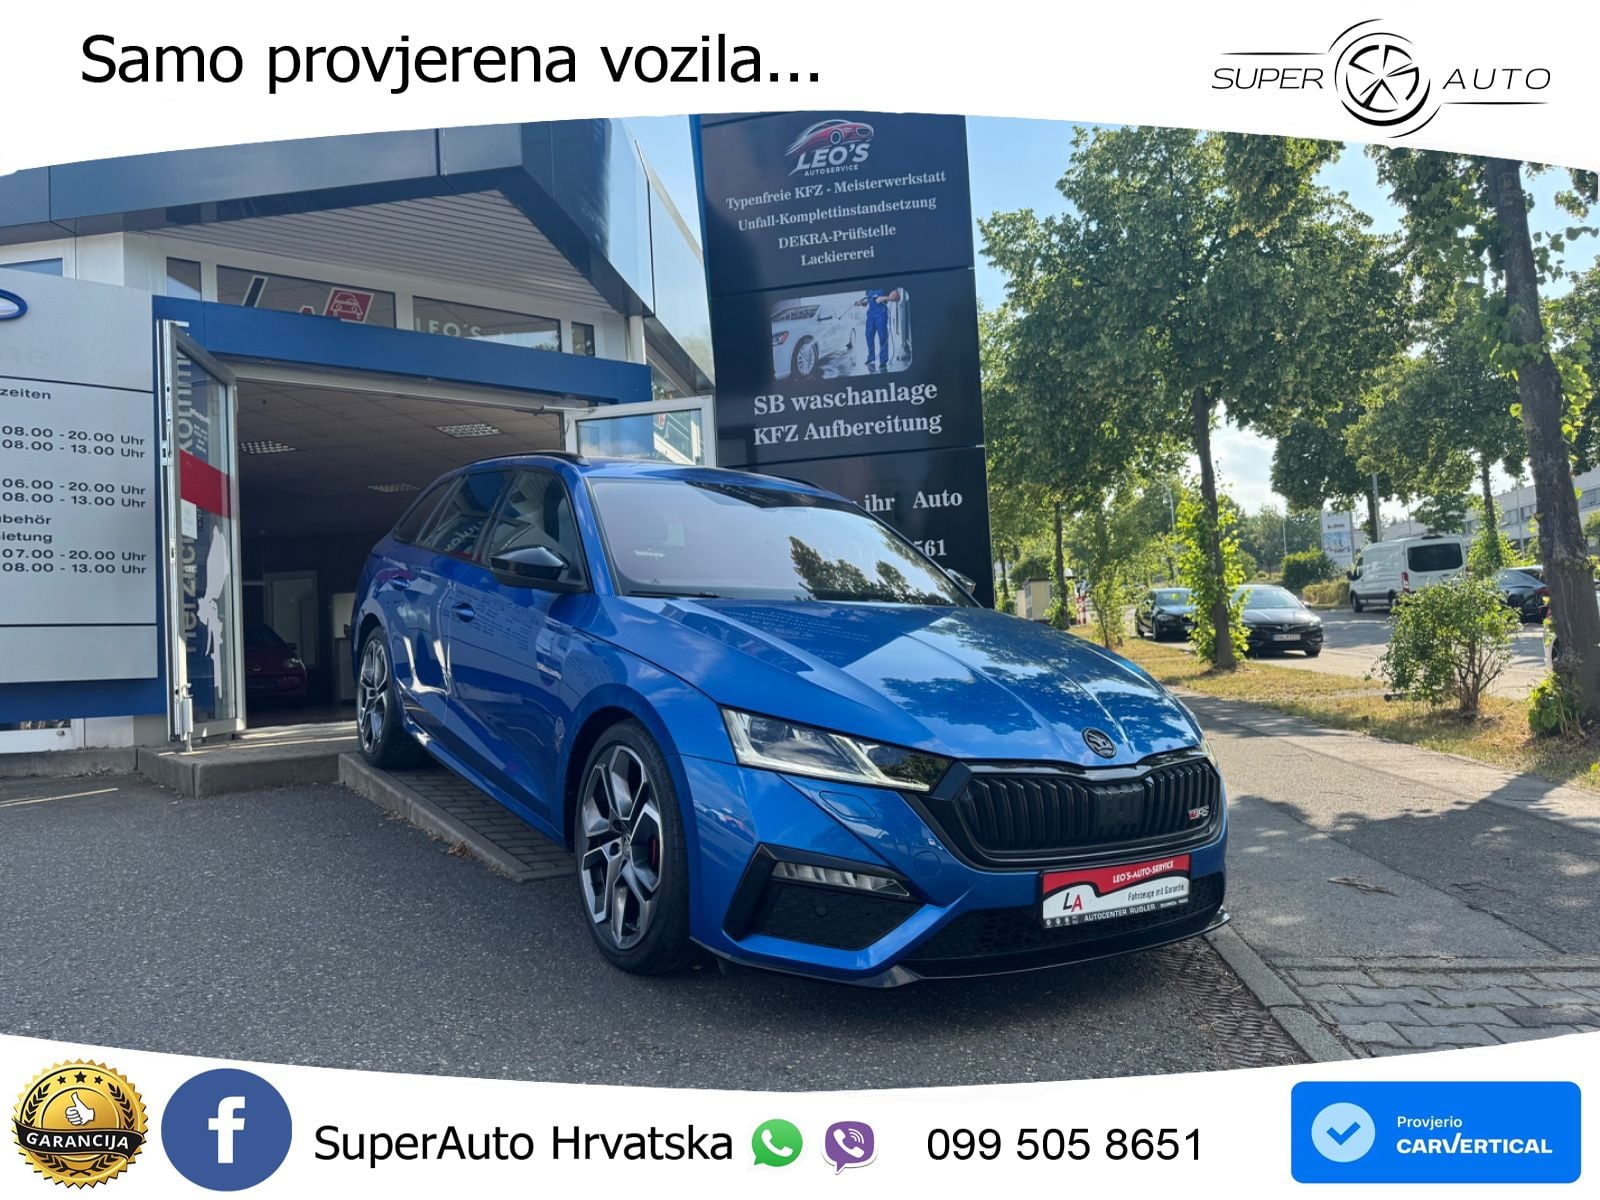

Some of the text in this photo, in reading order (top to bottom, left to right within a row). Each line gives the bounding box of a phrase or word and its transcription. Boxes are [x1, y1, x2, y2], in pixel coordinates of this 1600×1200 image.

[795, 142, 871, 172] LEO'S
[804, 164, 859, 177] AUTOSERVICE
[725, 189, 793, 211] Typenfreie
[795, 184, 824, 199] KFZ
[834, 170, 947, 194] Meisterwerkstatt
[738, 196, 938, 232] Unfall-Komplettinstandsetzung
[778, 224, 897, 249] DEKRA-Prüfstelle
[801, 246, 875, 267] Lackiererei
[0, 388, 51, 400] zeiten
[754, 382, 939, 416] SB waschanlage
[2, 425, 53, 439] 08.00
[68, 430, 115, 443] 20.00
[120, 434, 146, 446] Uhr
[753, 414, 942, 446] KFZ Aufbereitung
[2, 439, 53, 452] 08.00
[70, 444, 115, 456] 13.00
[120, 447, 146, 459] Uhr
[2, 478, 54, 490] 06.00
[68, 481, 115, 494] 20.00
[121, 484, 147, 496] Uhr
[2, 491, 54, 504] 08.00
[71, 495, 115, 507] 13.00
[121, 498, 147, 509] Uhr
[864, 488, 963, 513] ihr Auto
[0, 513, 52, 525] behör
[0, 531, 53, 545] ietung
[2, 548, 54, 560] 07.00
[68, 550, 116, 561] 20.00
[121, 551, 147, 562] Uhr
[2, 562, 54, 573] 08.00
[71, 563, 116, 574] 13.00
[121, 564, 147, 575] Uhr
[1062, 892, 1083, 912] LA
[1084, 909, 1127, 922] AUTOCENTER
